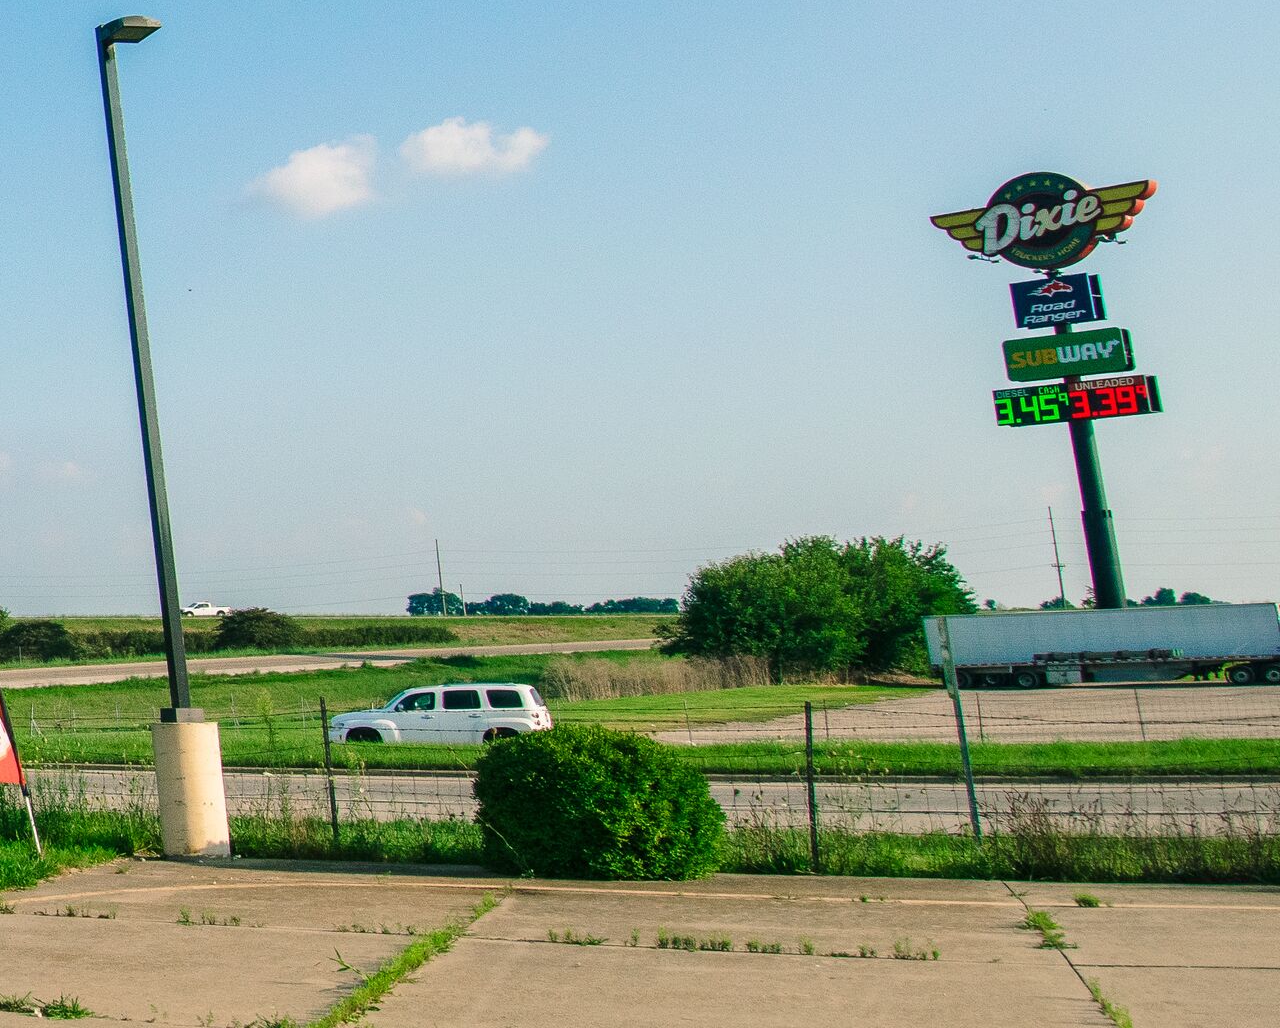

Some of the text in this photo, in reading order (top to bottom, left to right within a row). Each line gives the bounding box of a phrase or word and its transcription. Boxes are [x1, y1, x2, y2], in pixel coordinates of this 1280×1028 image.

[975, 189, 1102, 255] Dixie
[1056, 237, 1081, 256] HOME
[1031, 299, 1076, 313] Road
[1023, 309, 1087, 325] Ranger
[1010, 338, 1120, 369] SUBWAY
[1074, 377, 1135, 391] UNLEADED
[996, 389, 1029, 399] DIESEL
